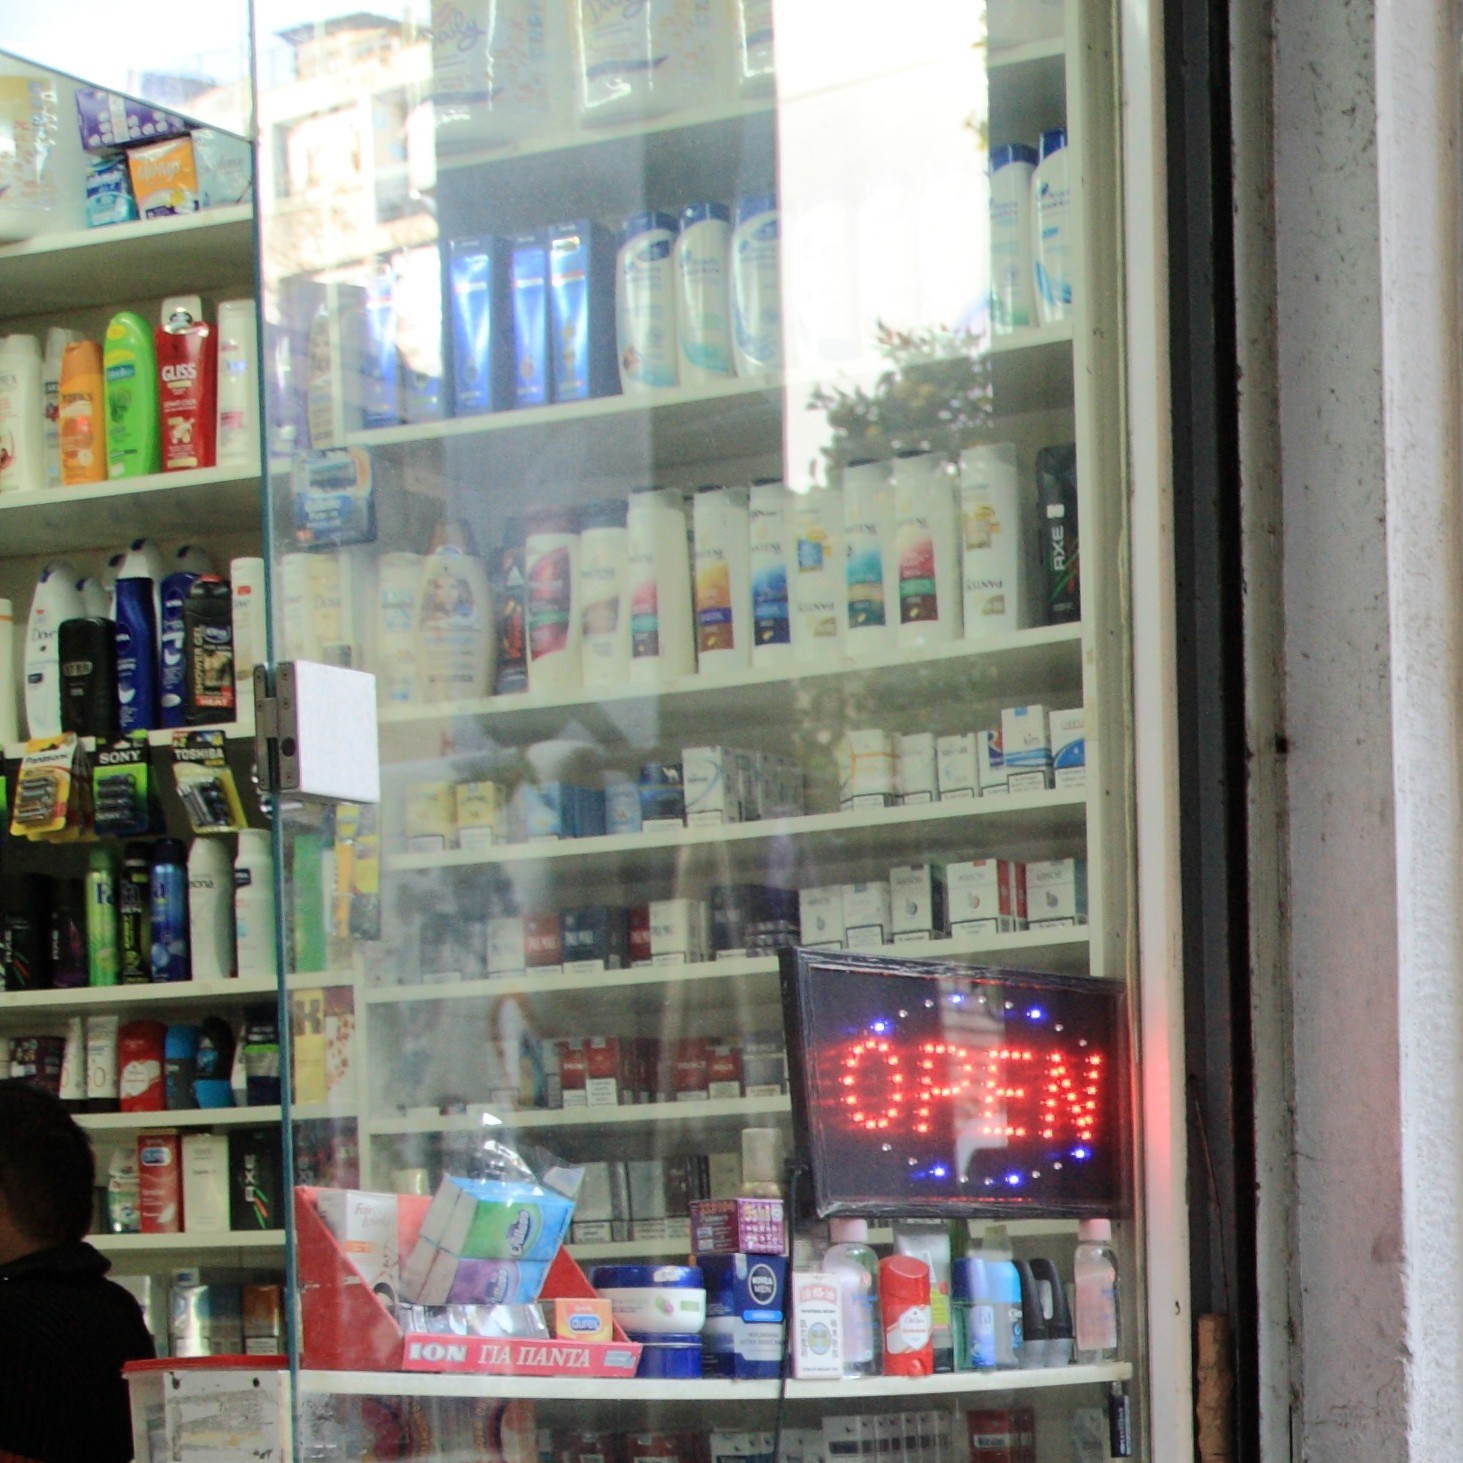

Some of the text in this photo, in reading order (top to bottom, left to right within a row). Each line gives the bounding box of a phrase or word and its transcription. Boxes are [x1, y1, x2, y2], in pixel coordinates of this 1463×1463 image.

[99, 750, 141, 764] SONY
[175, 748, 224, 761] TOSHIBA
[838, 1034, 1106, 1143] OPEN
[243, 1154, 258, 1202] AXE
[408, 1342, 466, 1362] ION
[478, 1345, 591, 1368] ΓΙΑ ΠΑΝΤΑ
